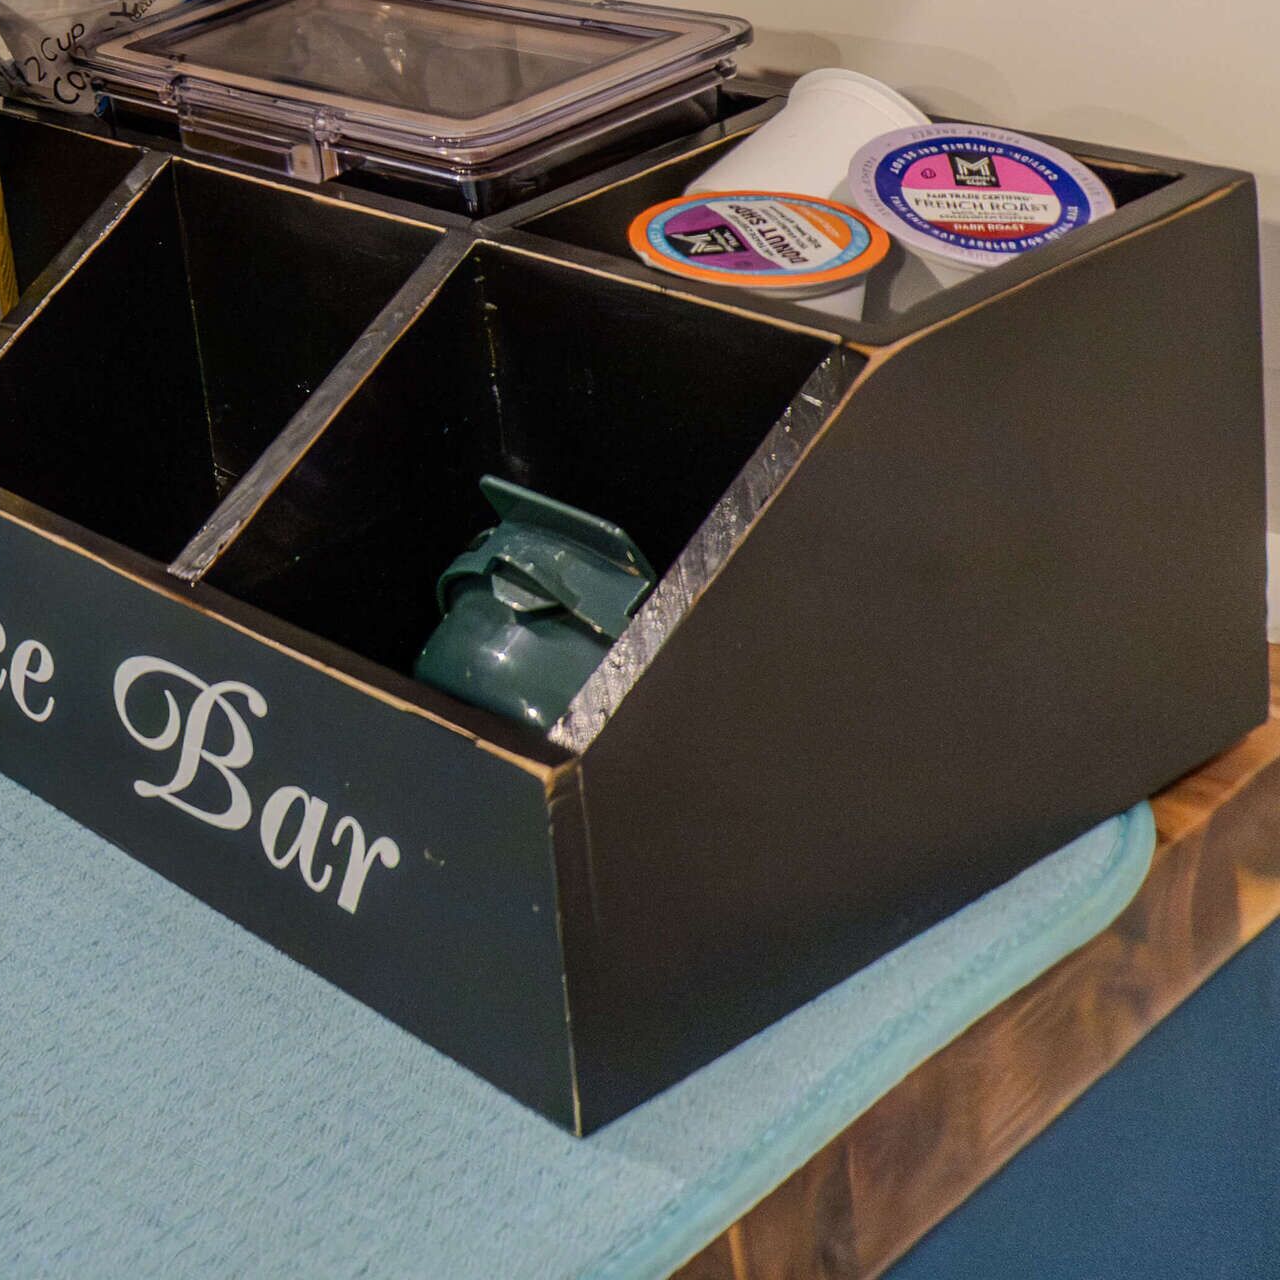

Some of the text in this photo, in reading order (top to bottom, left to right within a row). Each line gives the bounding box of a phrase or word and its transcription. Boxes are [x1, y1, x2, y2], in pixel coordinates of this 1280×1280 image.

[41, 23, 85, 61] CUP
[914, 198, 1048, 212] FRENCH ROAST
[953, 223, 1024, 232] DARK ROAST
[758, 228, 808, 263] DONUT
[113, 655, 401, 915] Bar
